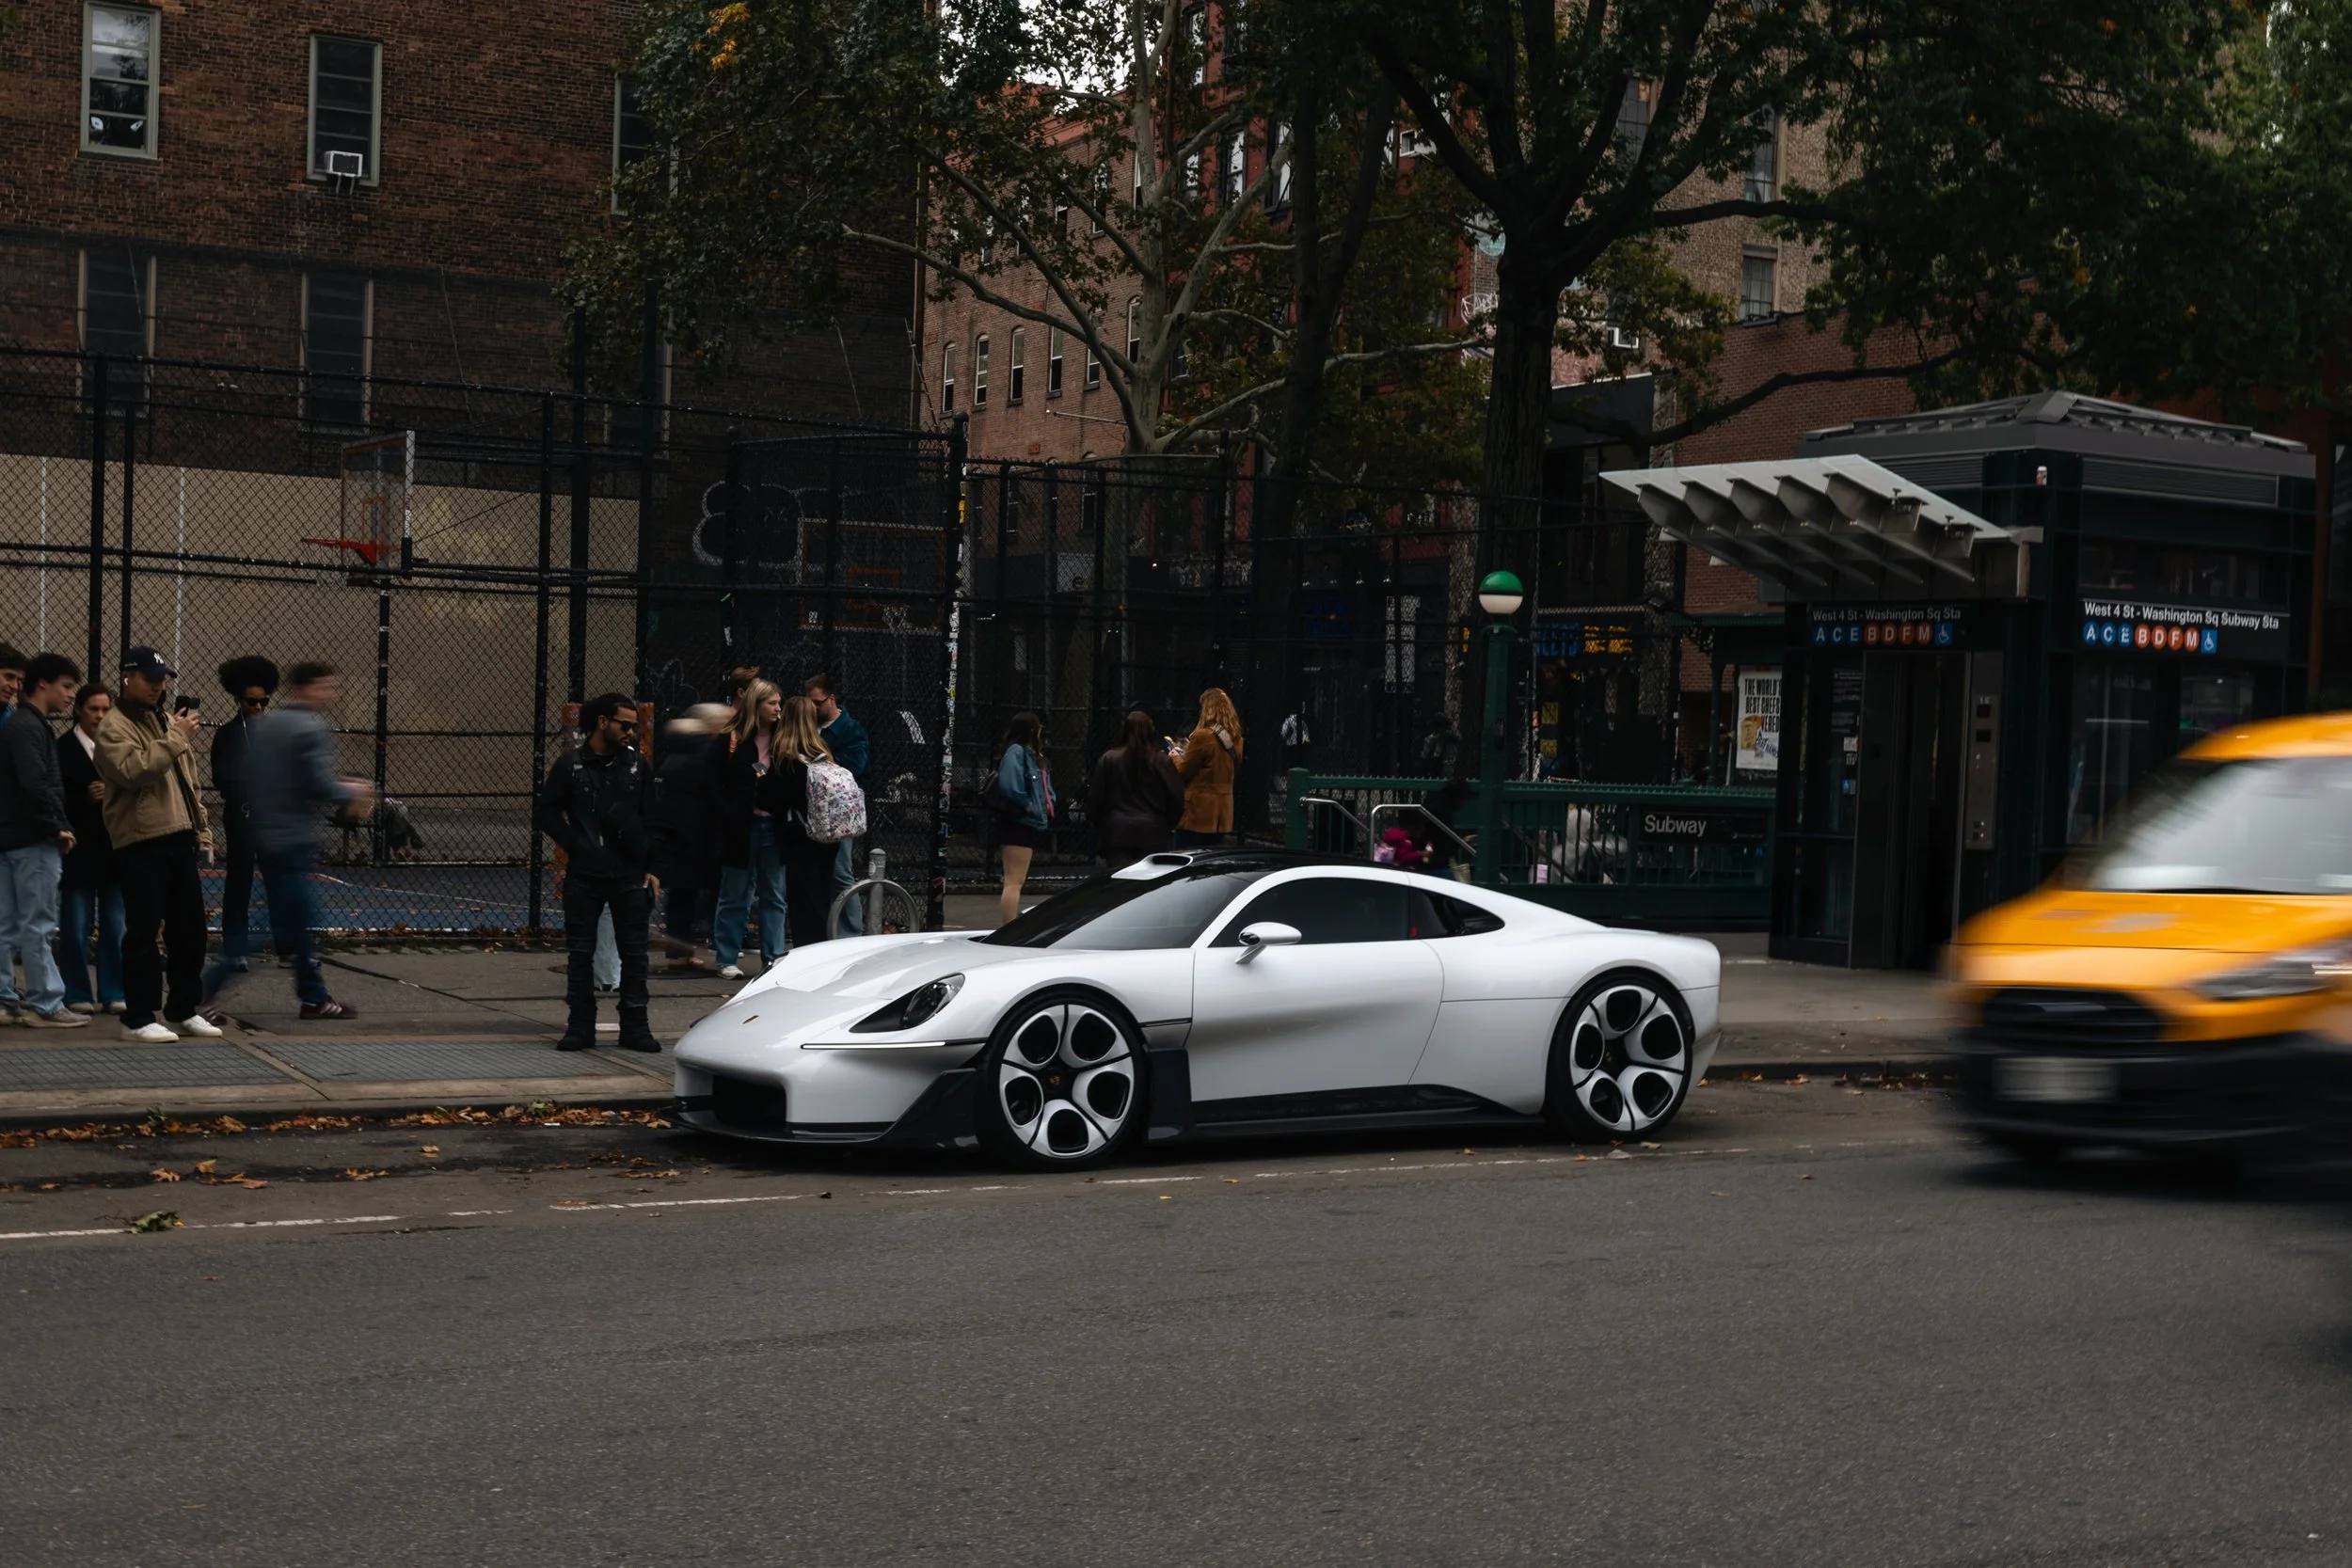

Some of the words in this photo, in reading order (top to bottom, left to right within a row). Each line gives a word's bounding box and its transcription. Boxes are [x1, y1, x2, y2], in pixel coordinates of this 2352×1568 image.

[1812, 609, 1836, 622] West
[1838, 609, 1845, 621] 4
[1847, 609, 1857, 622] St
[1865, 607, 1924, 623] Washington
[1927, 606, 1941, 622] Sq
[1943, 606, 1962, 621] Sta
[2085, 601, 2111, 618] West
[2113, 603, 2121, 618] 4
[2122, 604, 2135, 620] St
[2142, 605, 2203, 626] Washington
[2204, 610, 2219, 628] Sq
[2221, 611, 2261, 631] Subway
[2262, 613, 2280, 630] Sta
[1744, 678, 1755, 695] THE
[1746, 696, 1760, 714] BEST
[1761, 697, 1780, 715] CHEFS
[1644, 814, 1708, 838] Subway
